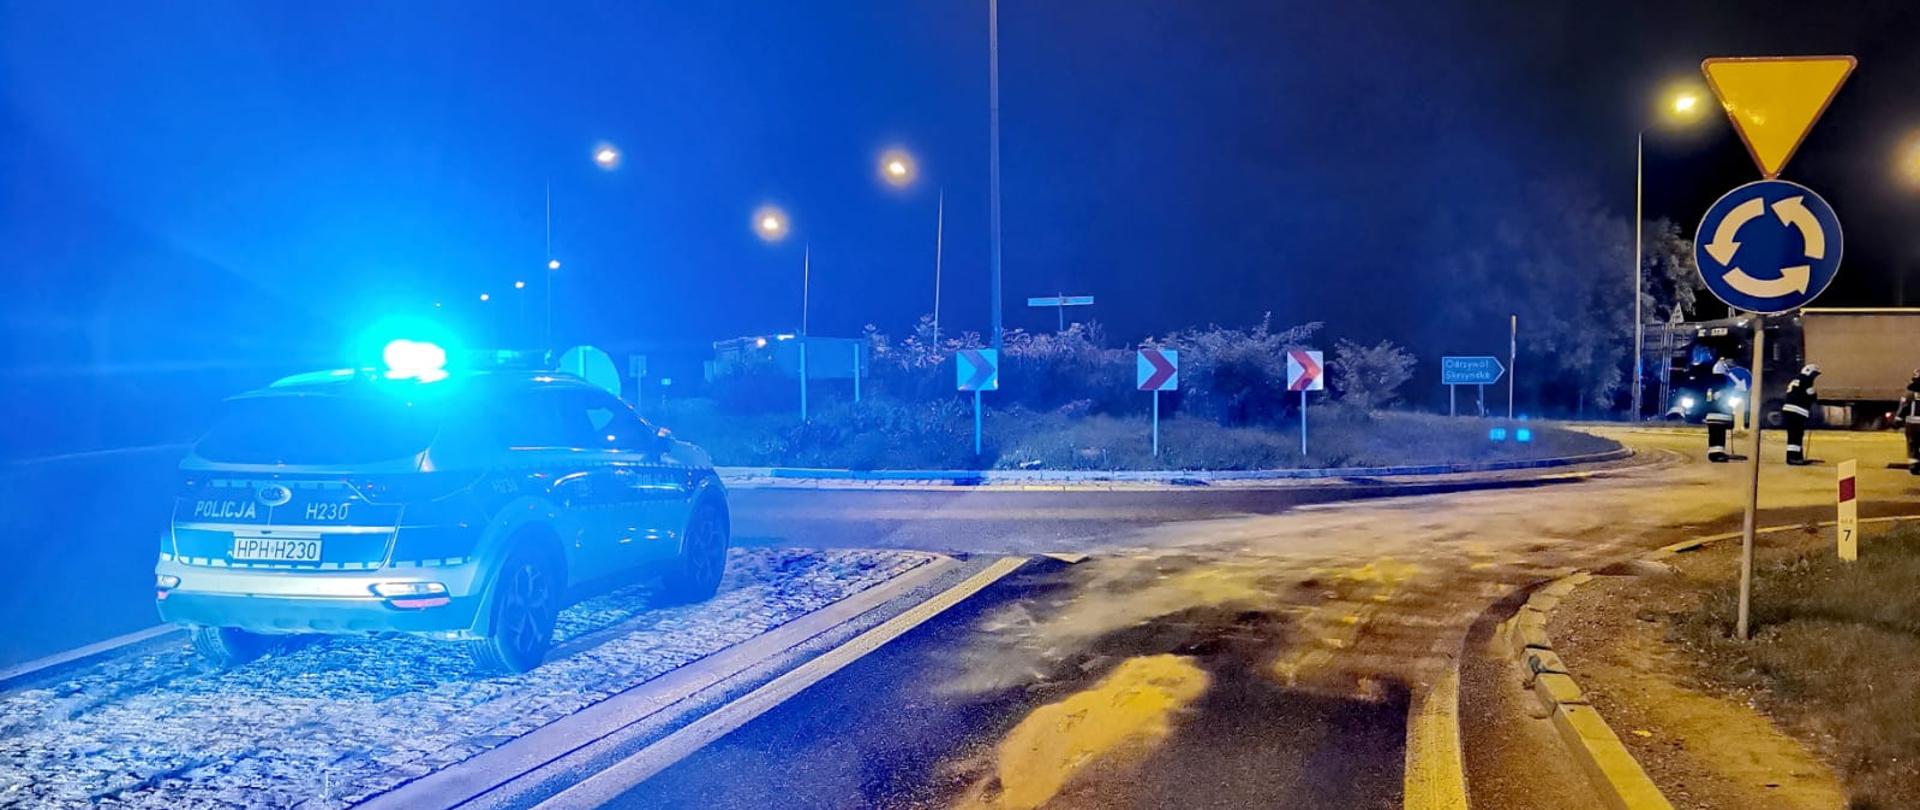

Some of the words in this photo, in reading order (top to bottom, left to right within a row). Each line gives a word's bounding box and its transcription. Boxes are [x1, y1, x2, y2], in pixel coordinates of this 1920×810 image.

[195, 501, 256, 519] POLICJA
[305, 504, 349, 520] H230
[1843, 529, 1851, 542] 7
